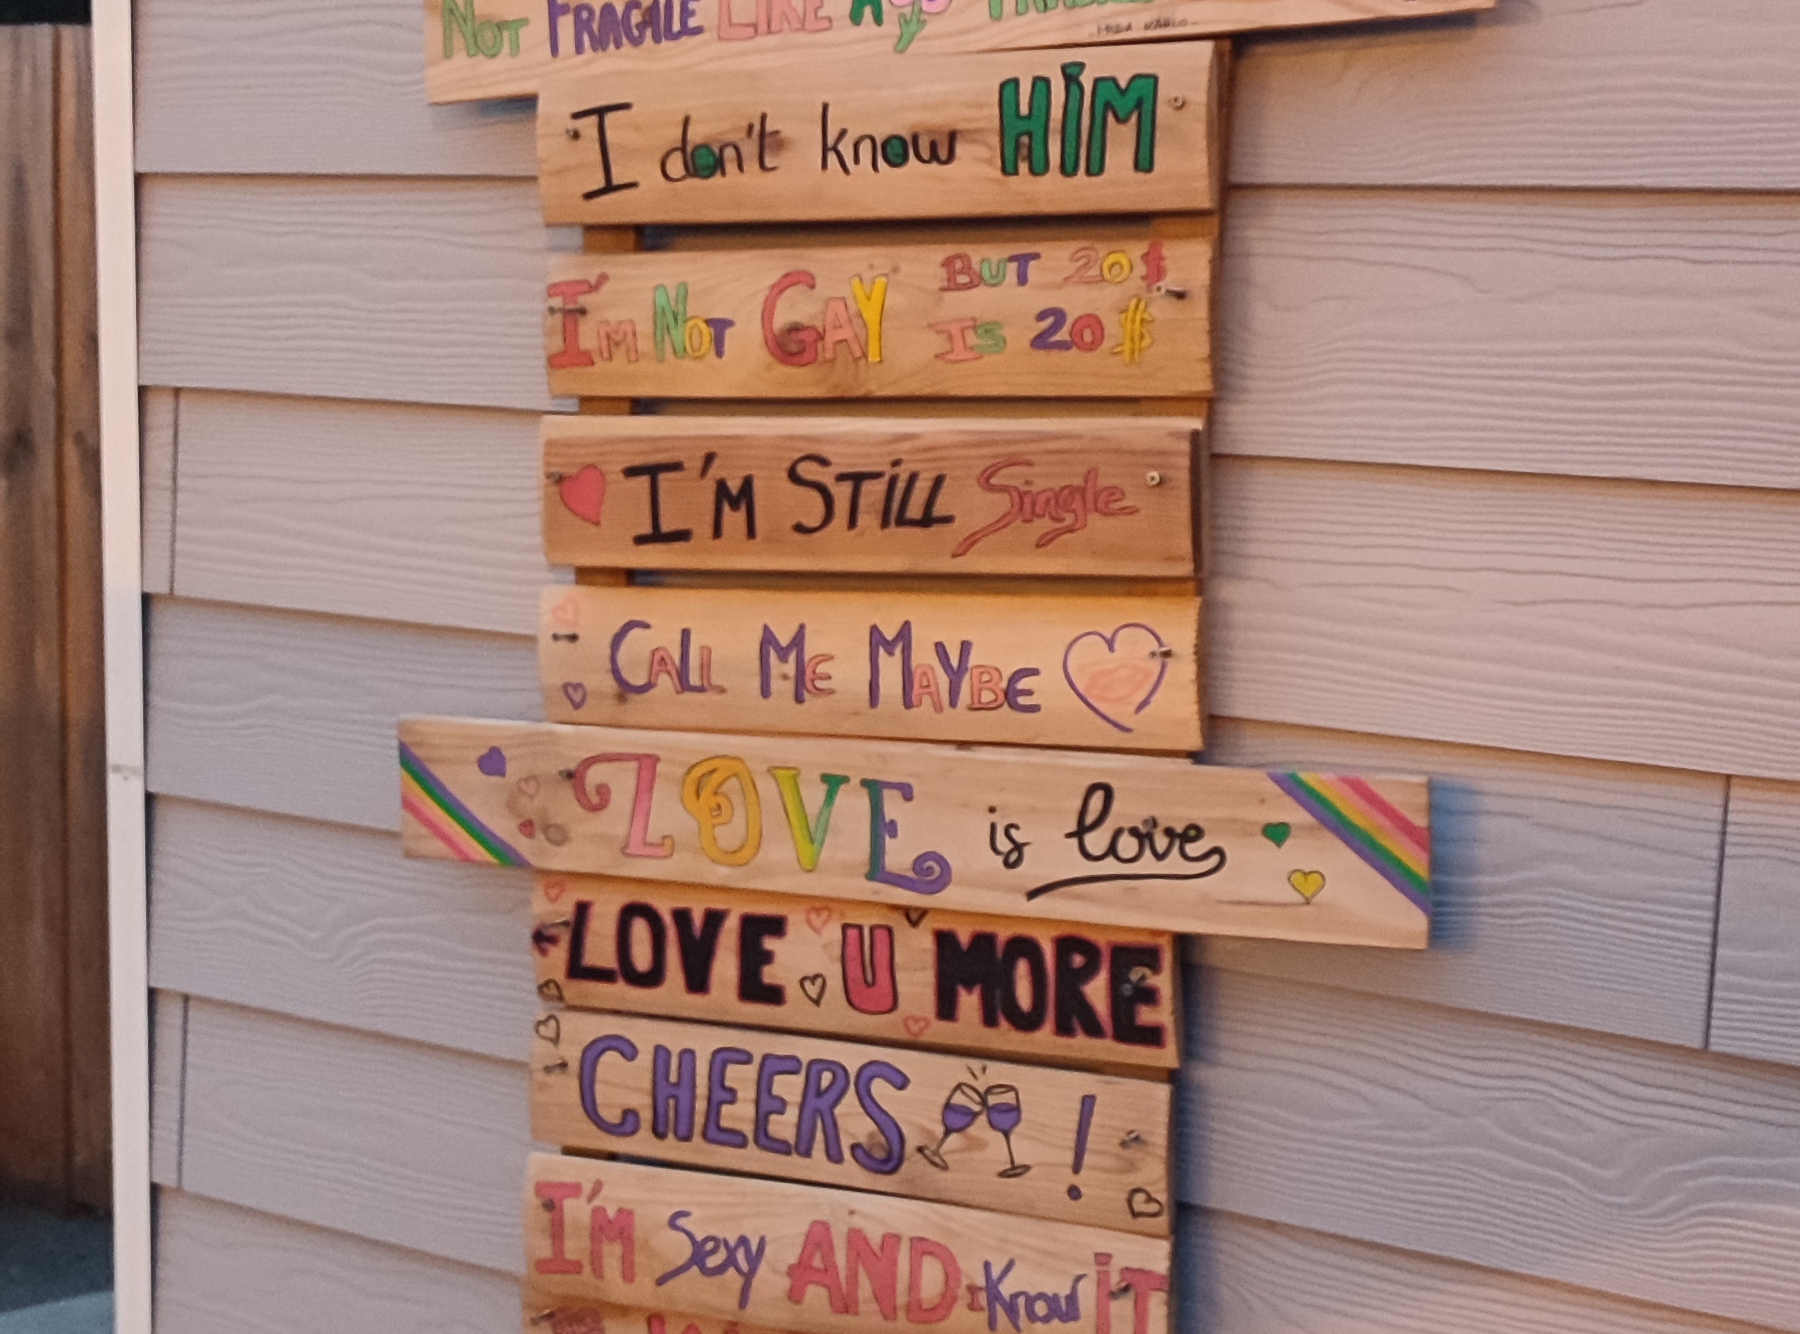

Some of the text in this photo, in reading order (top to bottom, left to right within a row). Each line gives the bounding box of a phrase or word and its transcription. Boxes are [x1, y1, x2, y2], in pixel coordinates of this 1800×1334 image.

[571, 62, 1158, 200] I don't know HIM
[547, 273, 638, 367] I'M
[762, 270, 888, 367] GAY
[935, 317, 1007, 361] IS
[939, 252, 1041, 292] BUT
[623, 452, 756, 545] I'M
[951, 454, 1139, 559] Single
[572, 752, 1226, 894] LOVE is love
[566, 901, 1166, 1049] LOVE U MORE
[579, 1034, 911, 1175] CHEERS
[534, 1179, 635, 1283] I'M
[657, 1210, 766, 1310] Sexy
[787, 1220, 961, 1324] AND
[981, 1259, 1087, 1333] Know
